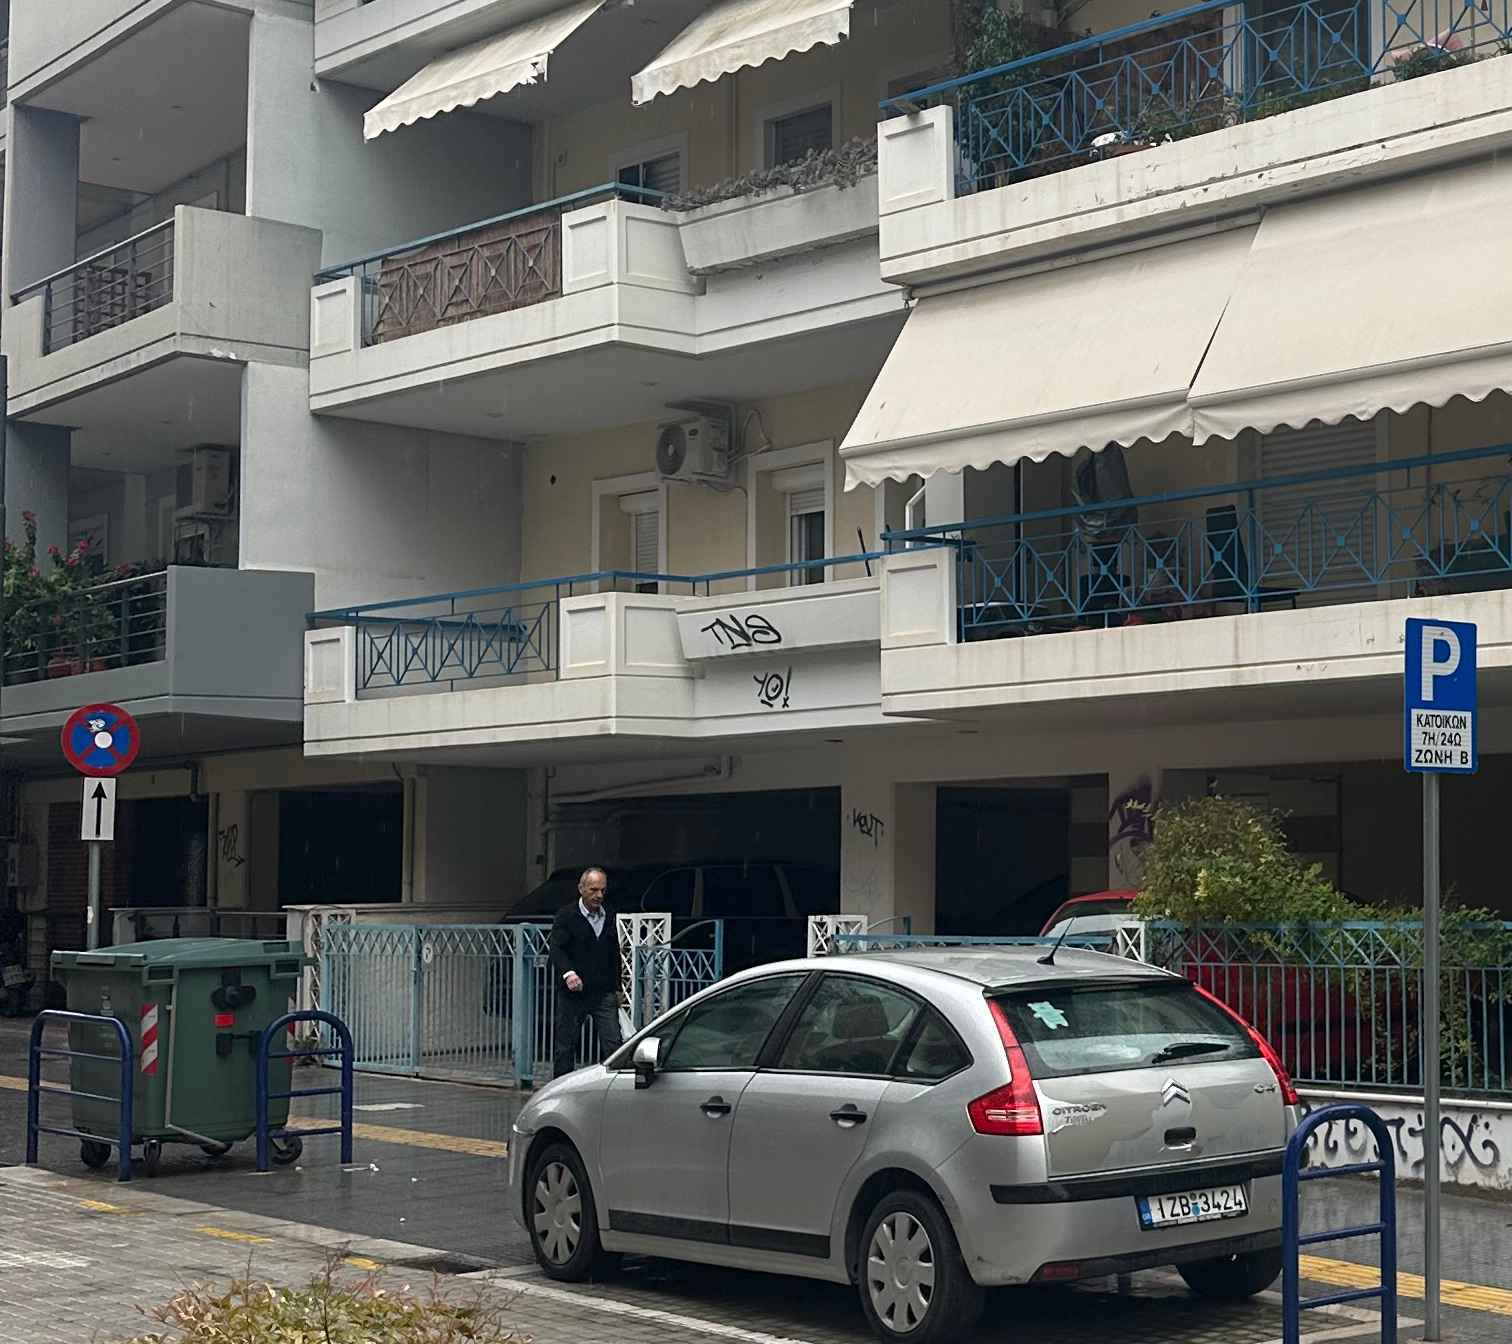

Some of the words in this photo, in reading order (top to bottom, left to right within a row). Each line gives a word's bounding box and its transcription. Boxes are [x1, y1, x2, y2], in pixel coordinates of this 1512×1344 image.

[1421, 625, 1461, 701] P
[1416, 713, 1467, 729] ΚΑΤΟΙΚΩΝ
[1415, 749, 1453, 765] ΖΩΝΗ
[1460, 751, 1469, 765] Β
